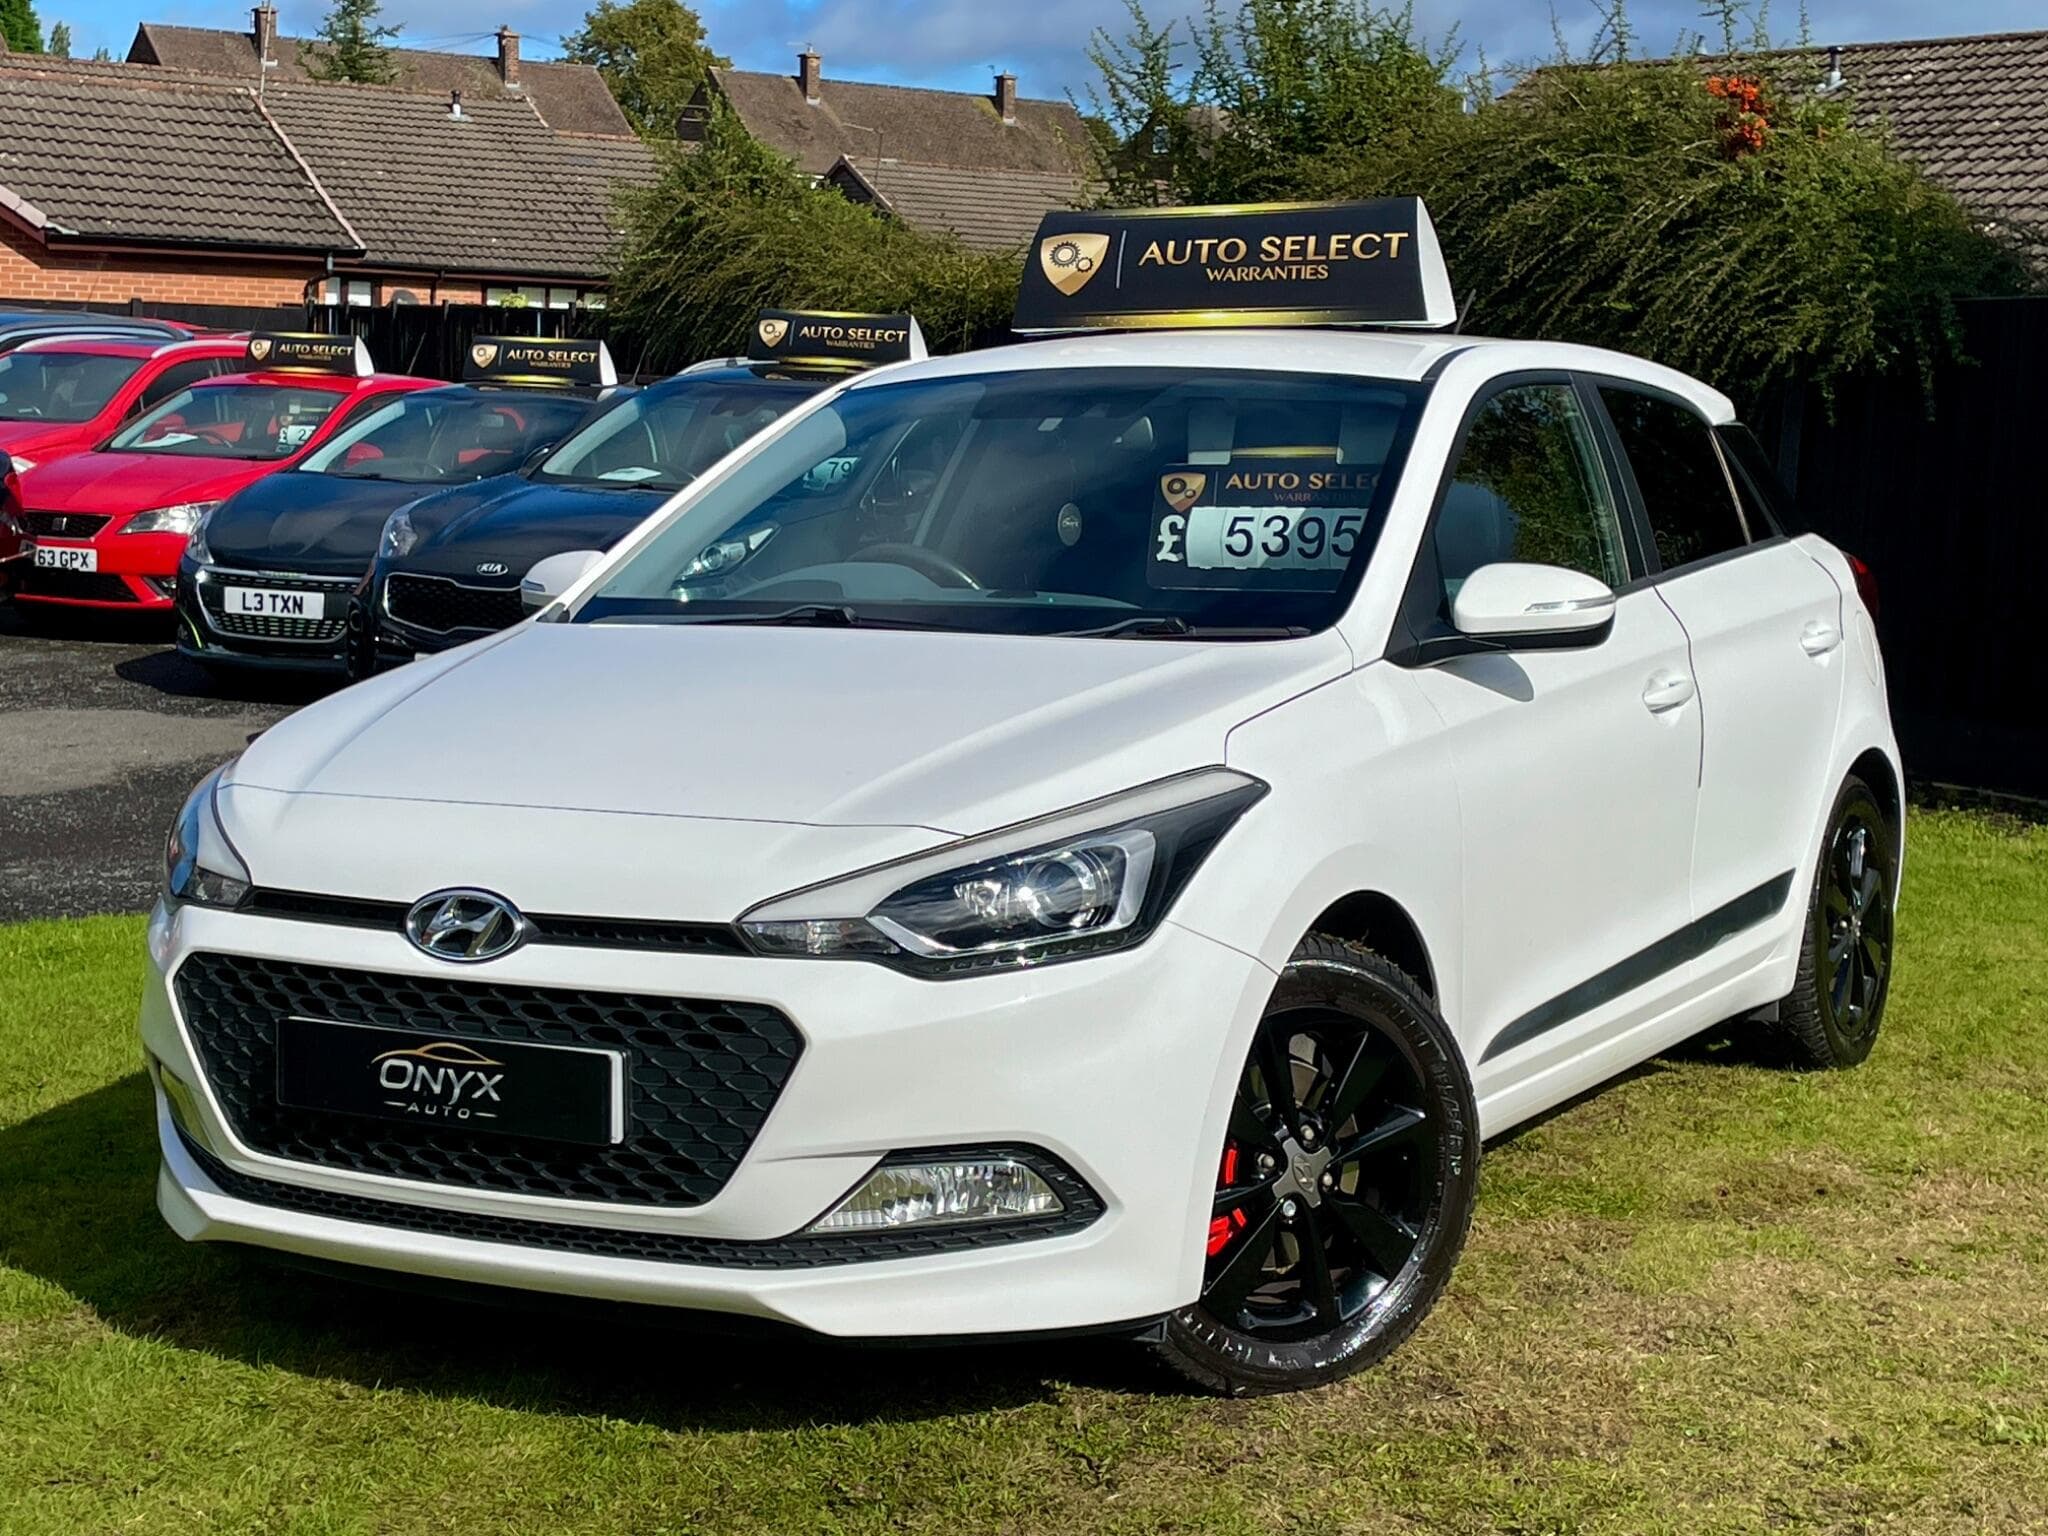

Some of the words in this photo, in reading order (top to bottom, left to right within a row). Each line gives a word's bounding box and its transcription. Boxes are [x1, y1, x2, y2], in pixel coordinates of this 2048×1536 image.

[1138, 238, 1248, 267] AUTO
[1259, 232, 1409, 263] SELECT
[1206, 264, 1330, 283] WARRANTIES
[799, 325, 844, 339] AUTO
[847, 328, 908, 343] SELECT
[279, 343, 310, 353] AUTO
[311, 345, 354, 356] SELECT
[826, 339, 876, 350] WARRANTIES
[506, 348, 545, 361] AUTO
[547, 350, 599, 363] SELECT
[1225, 473, 1301, 490] AUTO
[1155, 514, 1186, 563] £
[1224, 514, 1361, 559] 5395
[59, 551, 89, 568] GPX
[480, 563, 502, 574] KIA
[242, 591, 264, 612] L3
[268, 593, 304, 615] TXN
[379, 1058, 504, 1106] ONYX
[407, 1102, 471, 1119] AUTO
